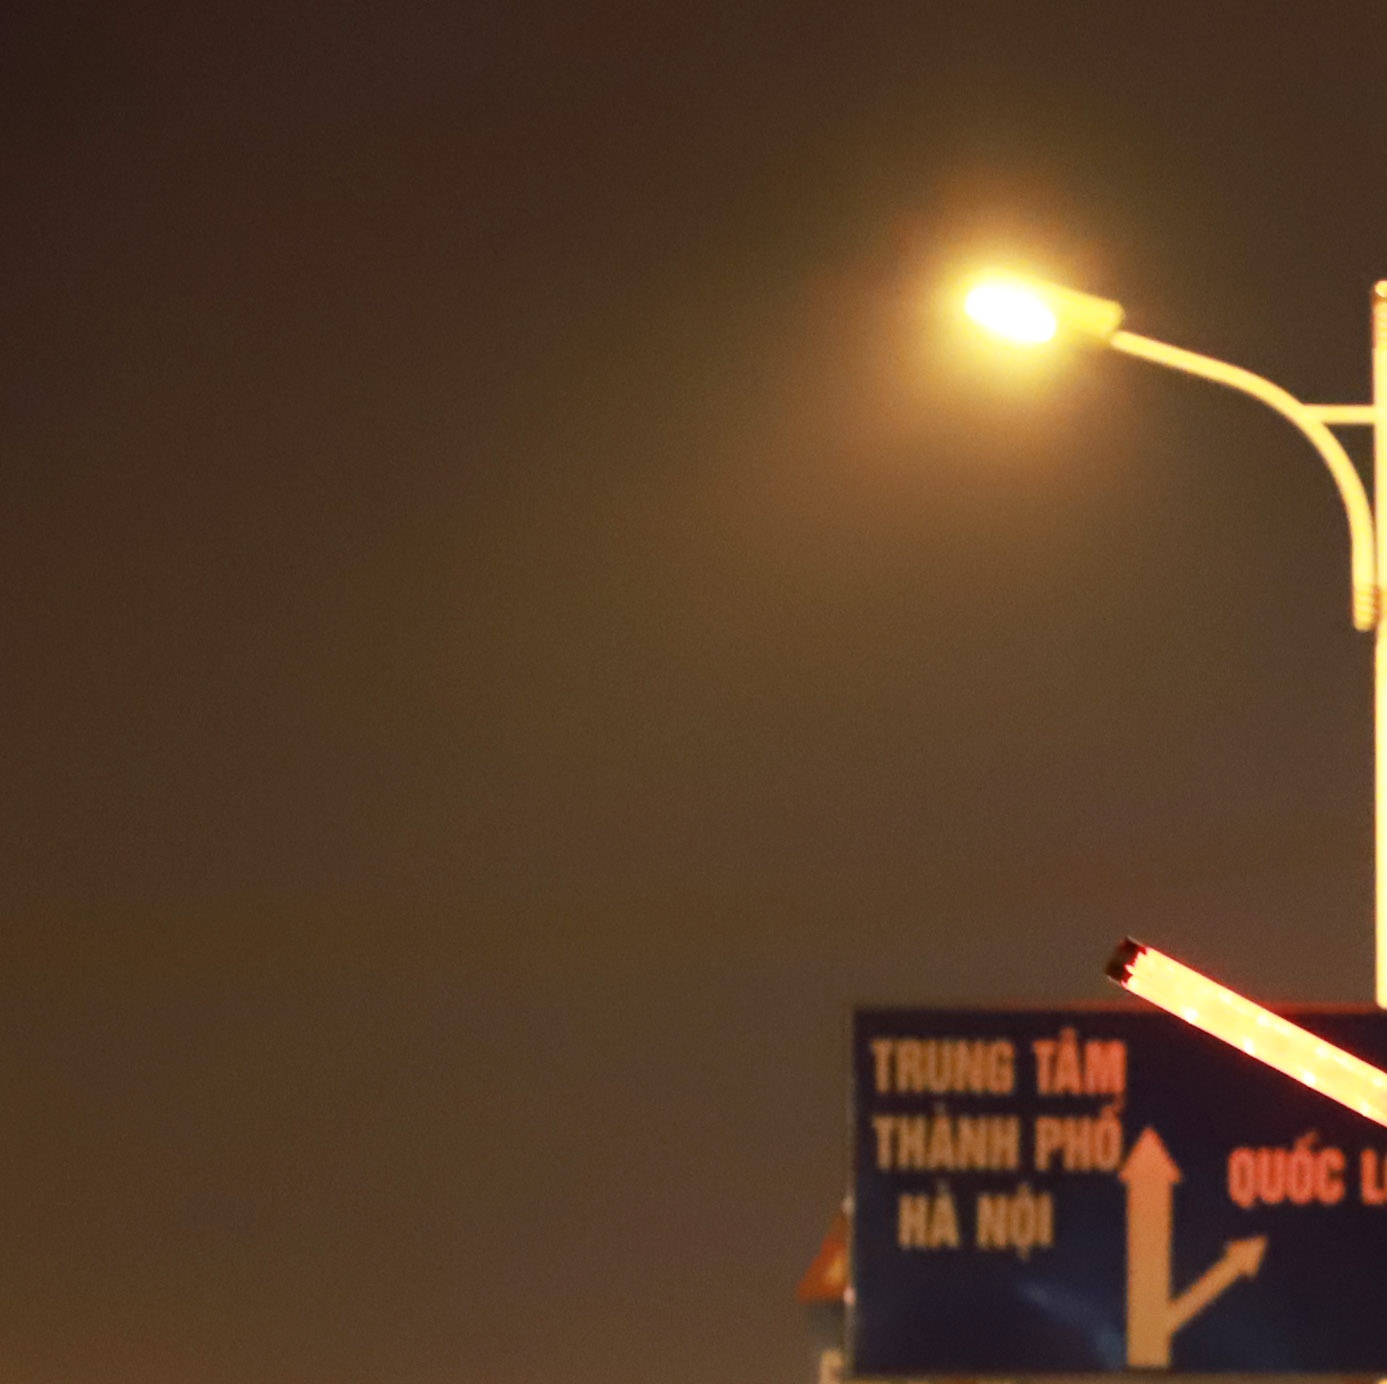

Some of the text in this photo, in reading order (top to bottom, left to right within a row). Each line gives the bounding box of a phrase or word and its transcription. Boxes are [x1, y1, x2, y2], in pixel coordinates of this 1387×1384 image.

[872, 1026, 1127, 1095] TRUNG TÂM
[874, 1096, 1125, 1172] THÀNH PHỐ
[1227, 1129, 1347, 1208] QUỐC
[898, 1180, 1056, 1262] HÀ NỘI
